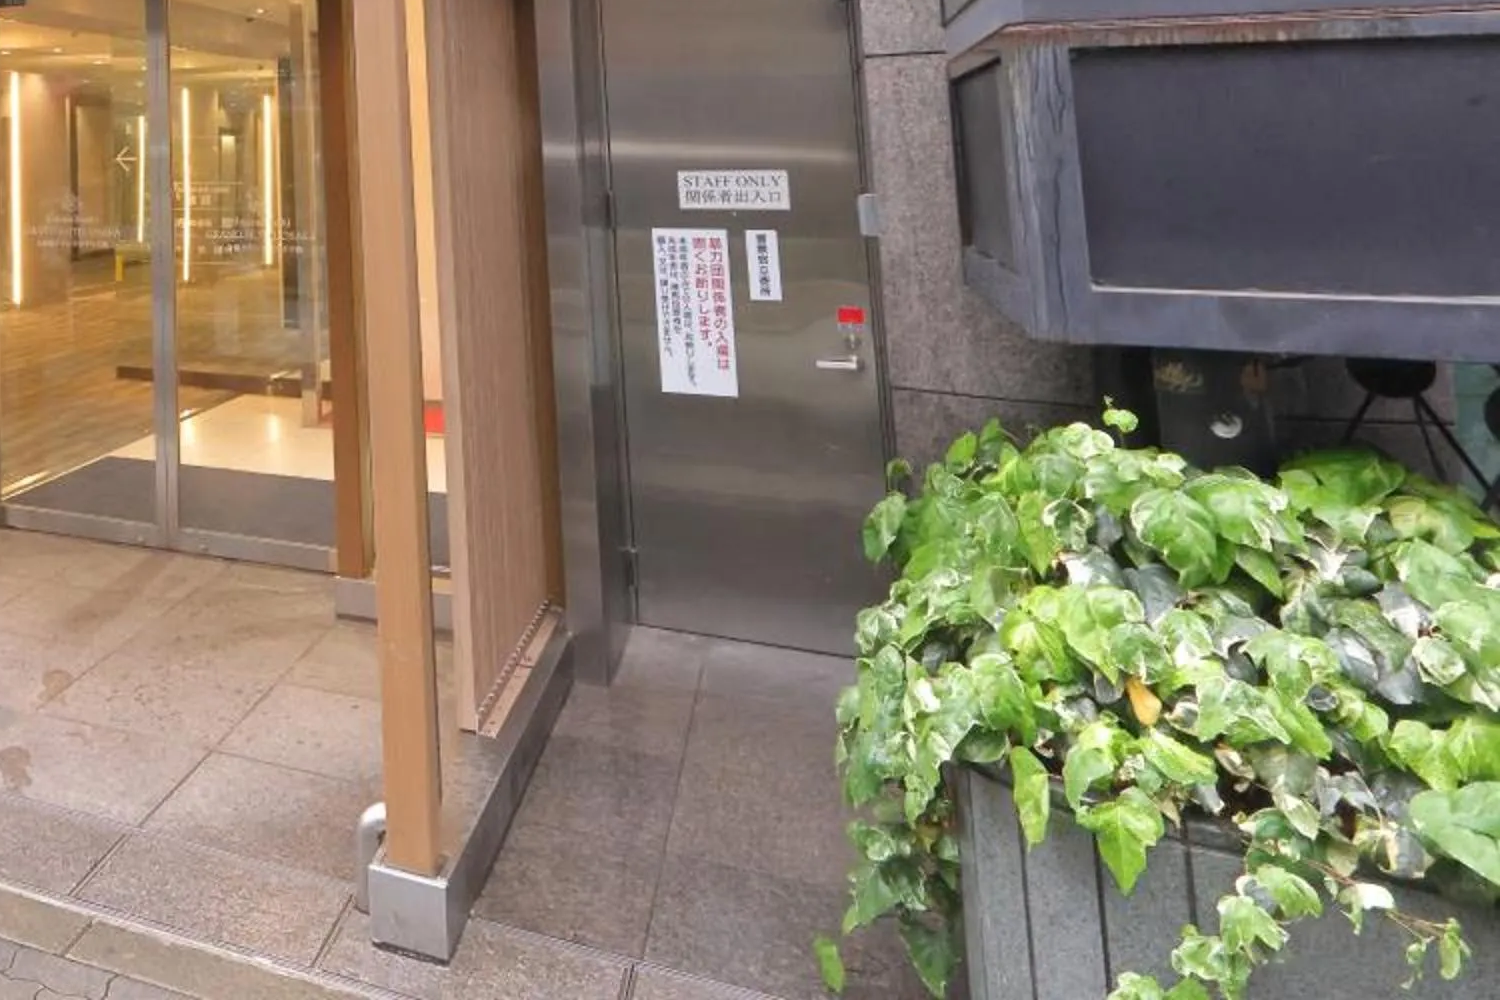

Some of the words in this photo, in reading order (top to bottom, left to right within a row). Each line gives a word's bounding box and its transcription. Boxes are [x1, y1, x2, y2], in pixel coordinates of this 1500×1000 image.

[683, 175, 730, 188] STAFF
[735, 175, 781, 187] ONLY
[685, 189, 781, 204] 関係者出入口
